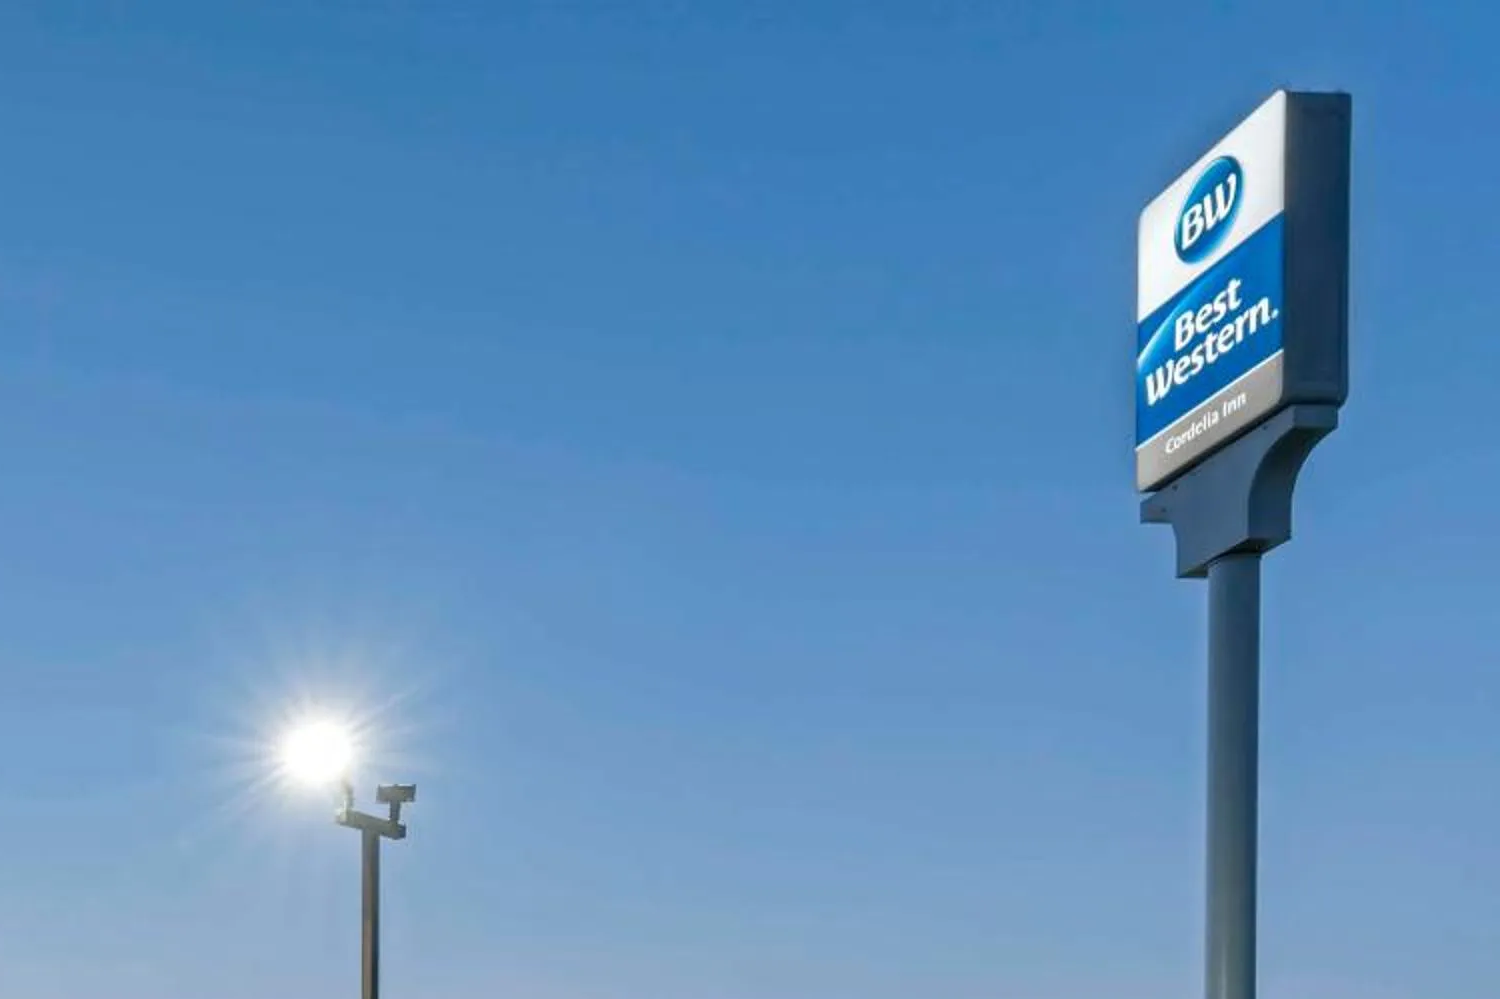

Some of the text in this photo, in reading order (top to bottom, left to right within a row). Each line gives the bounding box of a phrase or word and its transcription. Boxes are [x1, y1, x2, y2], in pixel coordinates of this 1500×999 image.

[1182, 173, 1237, 250] BW
[1175, 278, 1242, 350] Best
[1223, 392, 1247, 417] Inn
